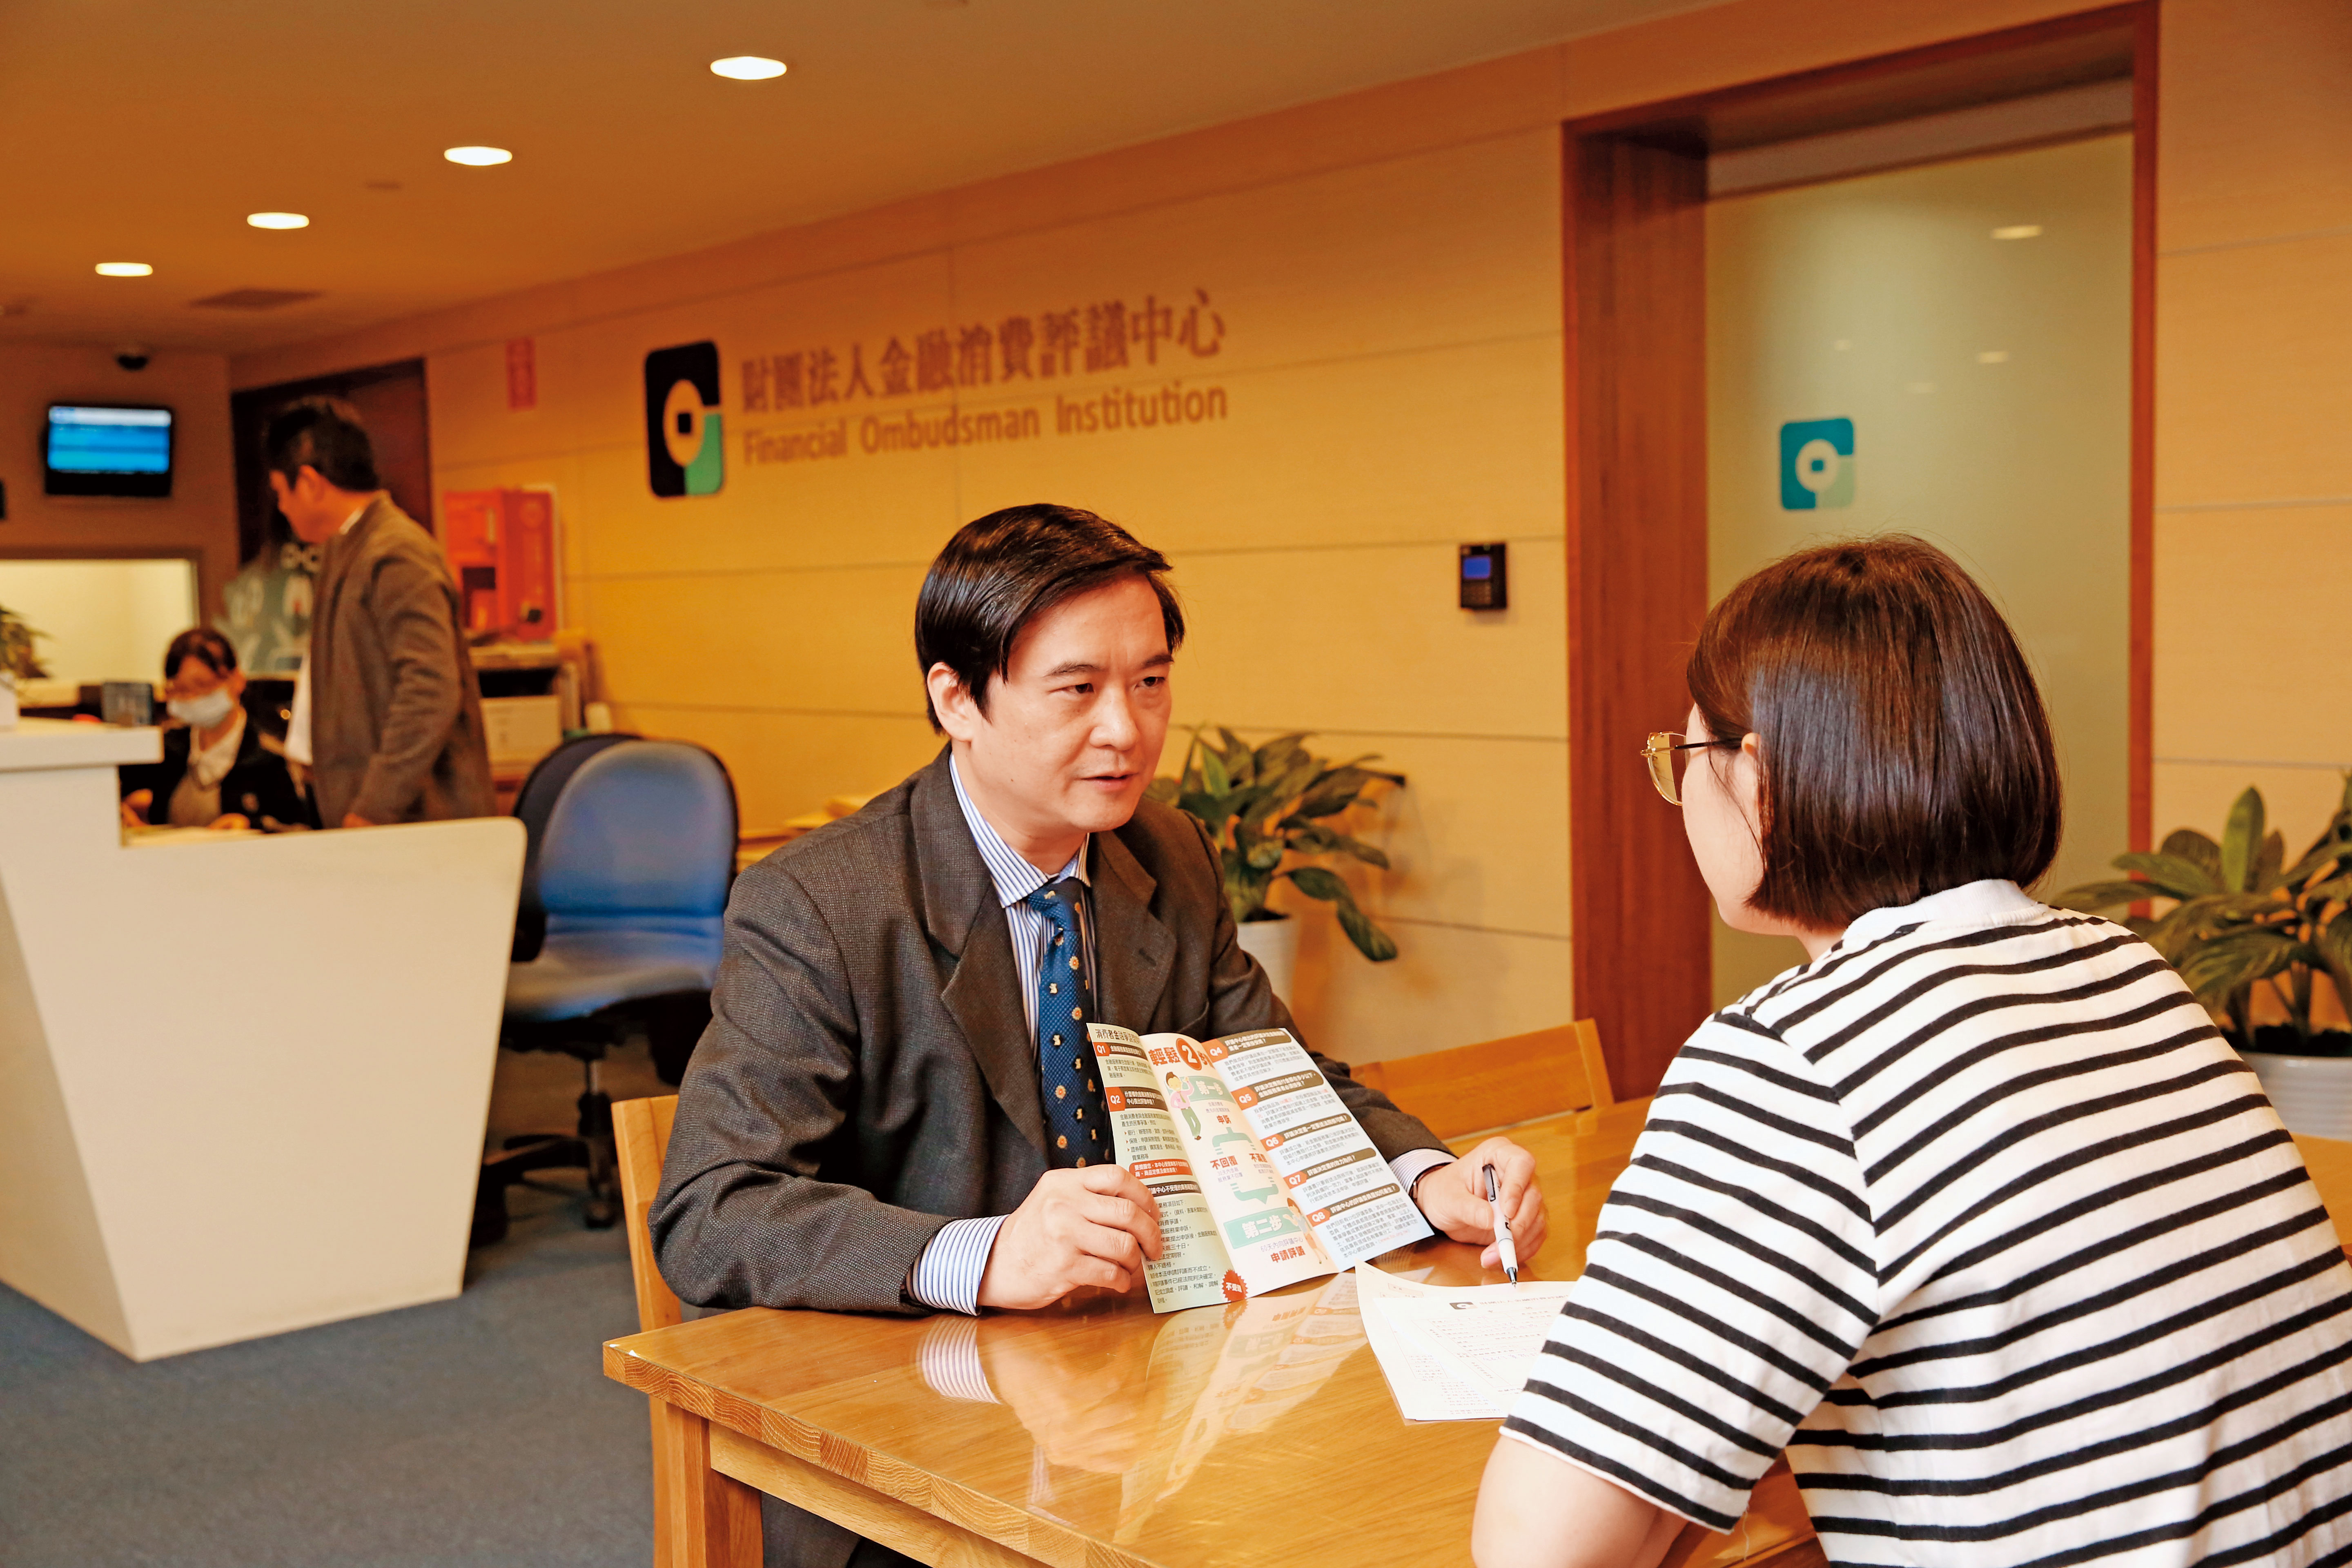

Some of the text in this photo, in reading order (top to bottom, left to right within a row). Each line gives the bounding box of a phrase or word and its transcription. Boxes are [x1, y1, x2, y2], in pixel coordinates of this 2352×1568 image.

[742, 287, 1224, 413] 財團法人金融消費評議中心
[743, 381, 1227, 466] Financial Ombudsman Institution
[1097, 1045, 1106, 1054] Q1
[1209, 1047, 1223, 1056] Q4
[1196, 1080, 1223, 1096] 第一步
[1110, 1095, 1120, 1105] Q2
[1238, 1094, 1252, 1103] Q5
[1216, 1115, 1232, 1125] 申訴
[1265, 1137, 1279, 1147] Q6
[1210, 1155, 1238, 1170] 不回覆
[1289, 1175, 1301, 1185] Q7
[1157, 1200, 1186, 1208] 業務項目如下：
[1312, 1212, 1325, 1222] Q8
[1242, 1215, 1283, 1239] 第二步
[1261, 1236, 1303, 1252] 60天內向評議中心
[1270, 1246, 1306, 1263] 申請評議
[1226, 1282, 1243, 1293] 不受理
